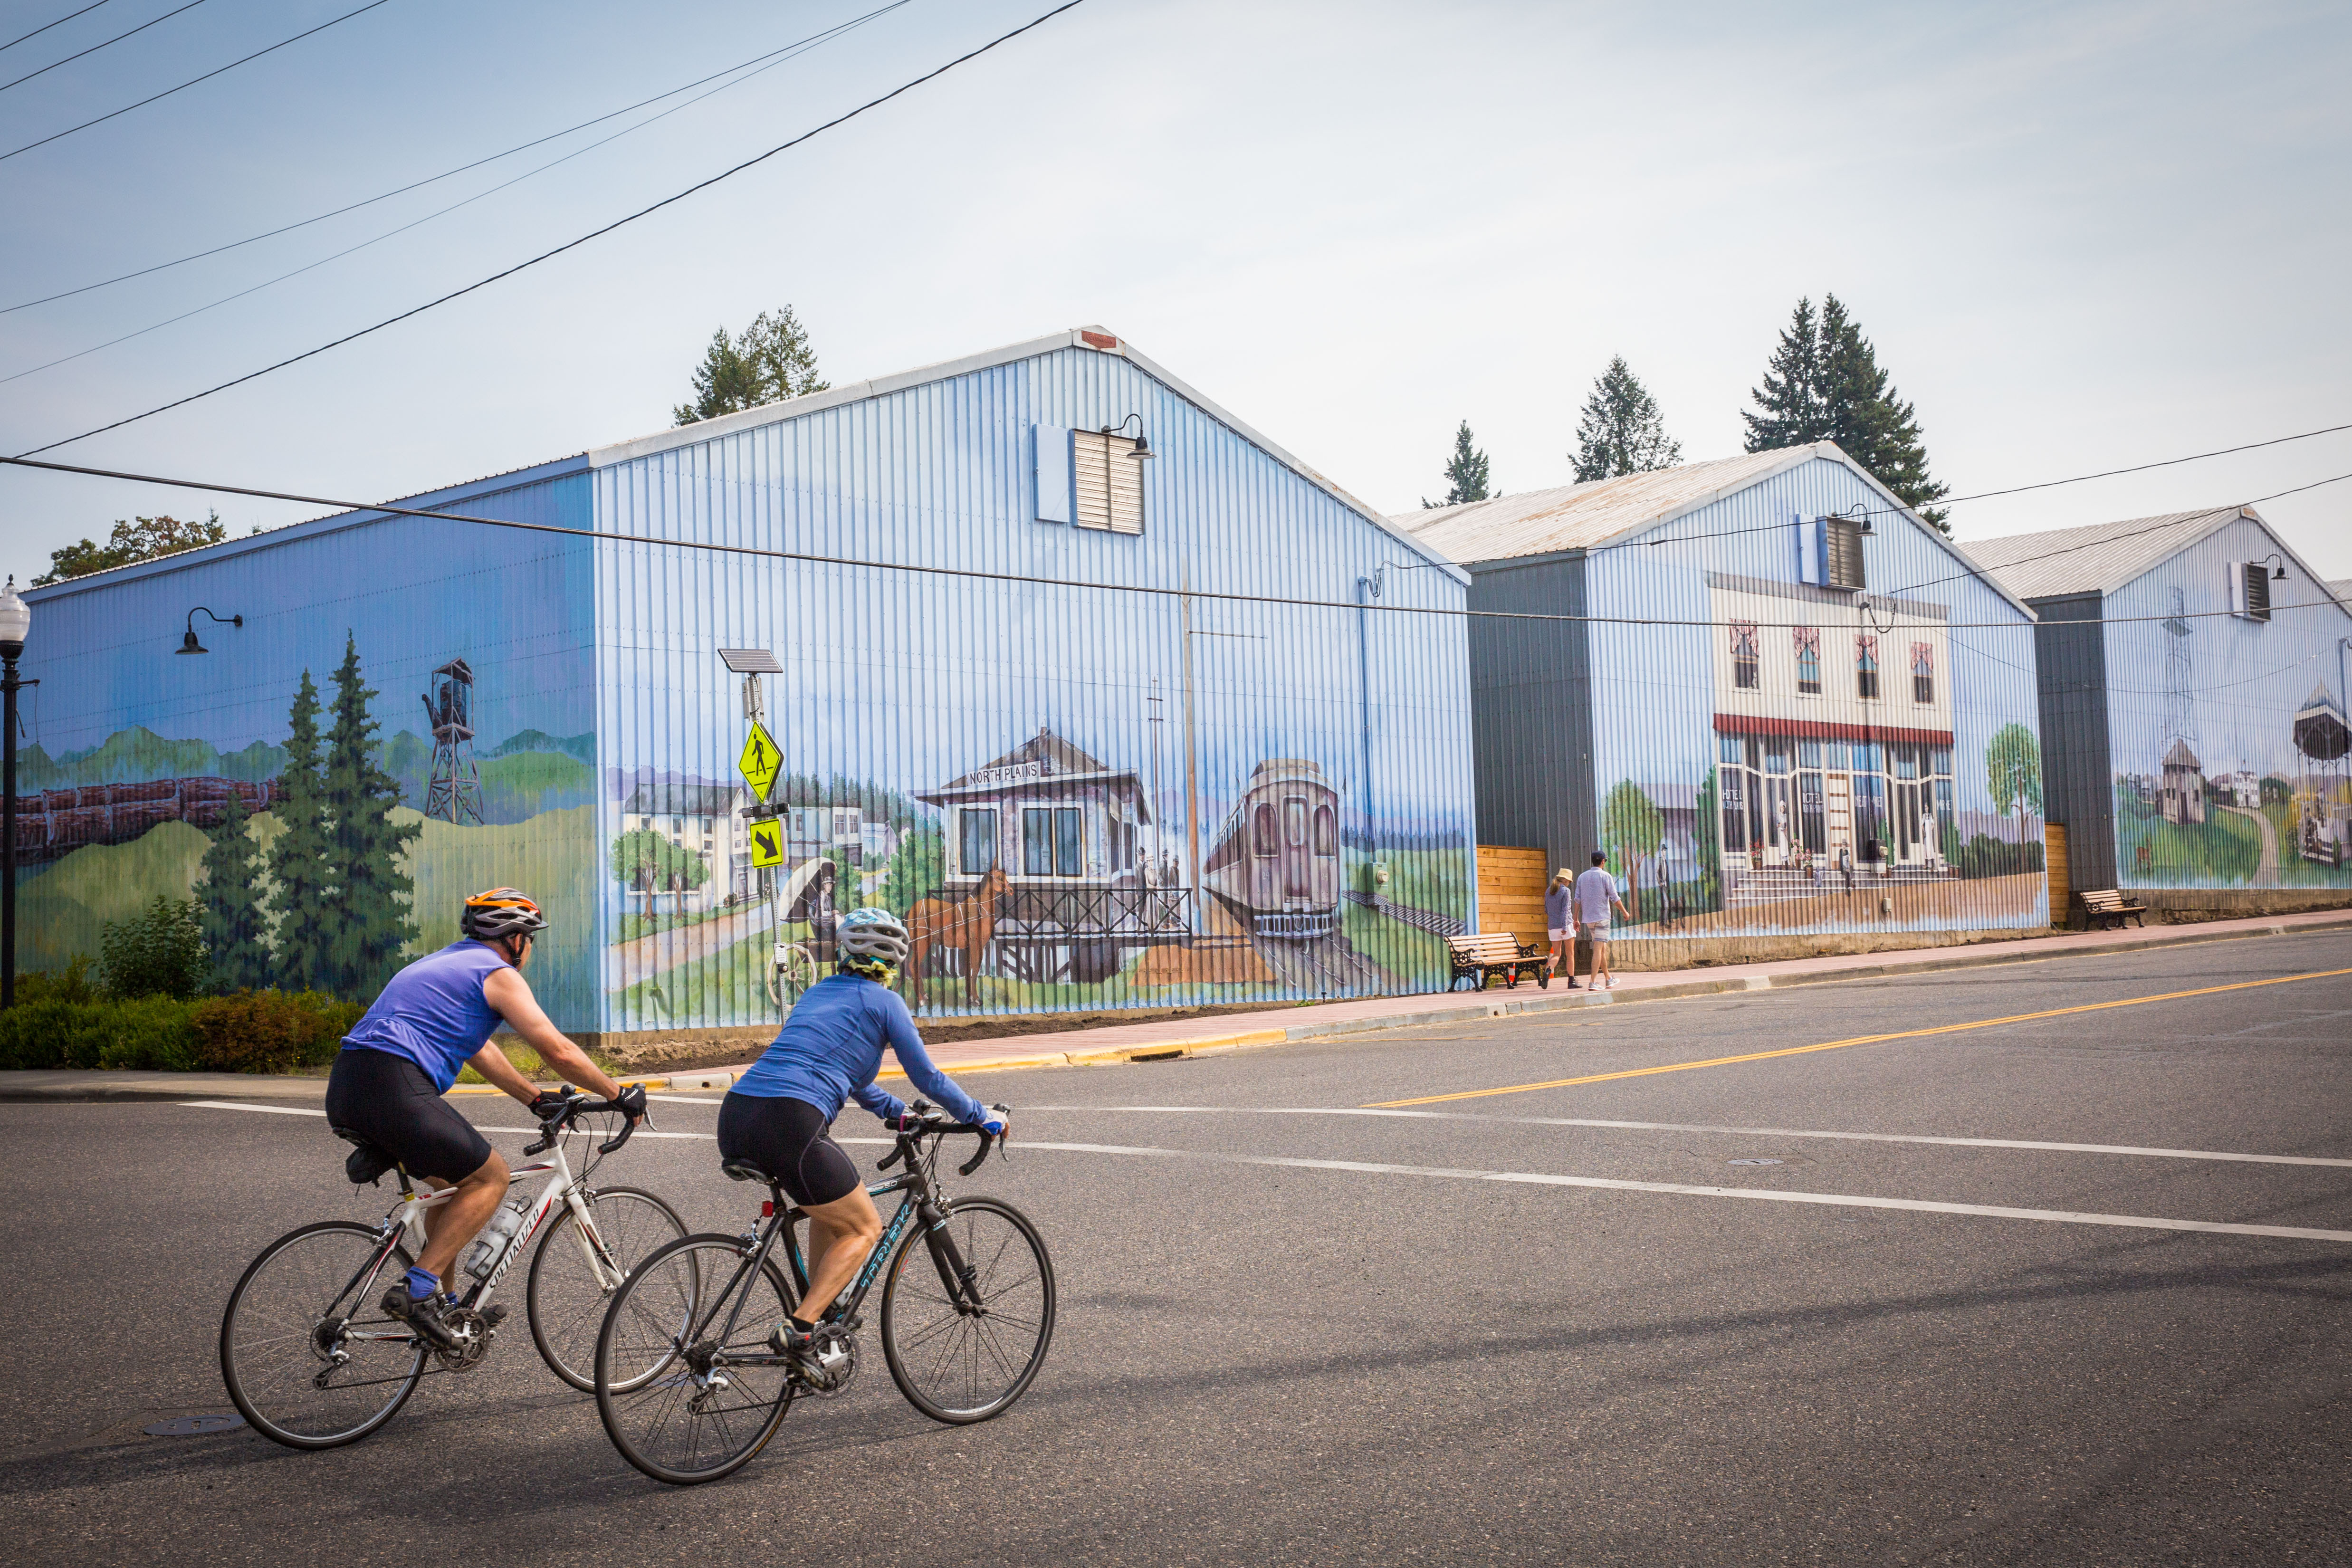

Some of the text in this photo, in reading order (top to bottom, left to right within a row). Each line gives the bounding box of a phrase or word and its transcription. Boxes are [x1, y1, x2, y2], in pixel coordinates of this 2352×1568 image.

[970, 764, 1037, 784] NORTH PLAINS
[1722, 789, 1742, 800] HOTEL
[1802, 792, 1823, 803] HOTEL
[1722, 801, 1733, 810] NOTH
[1262, 871, 1270, 880] 24
[489, 1208, 539, 1289] SPECIALIZED
[860, 1204, 912, 1287] TREK
